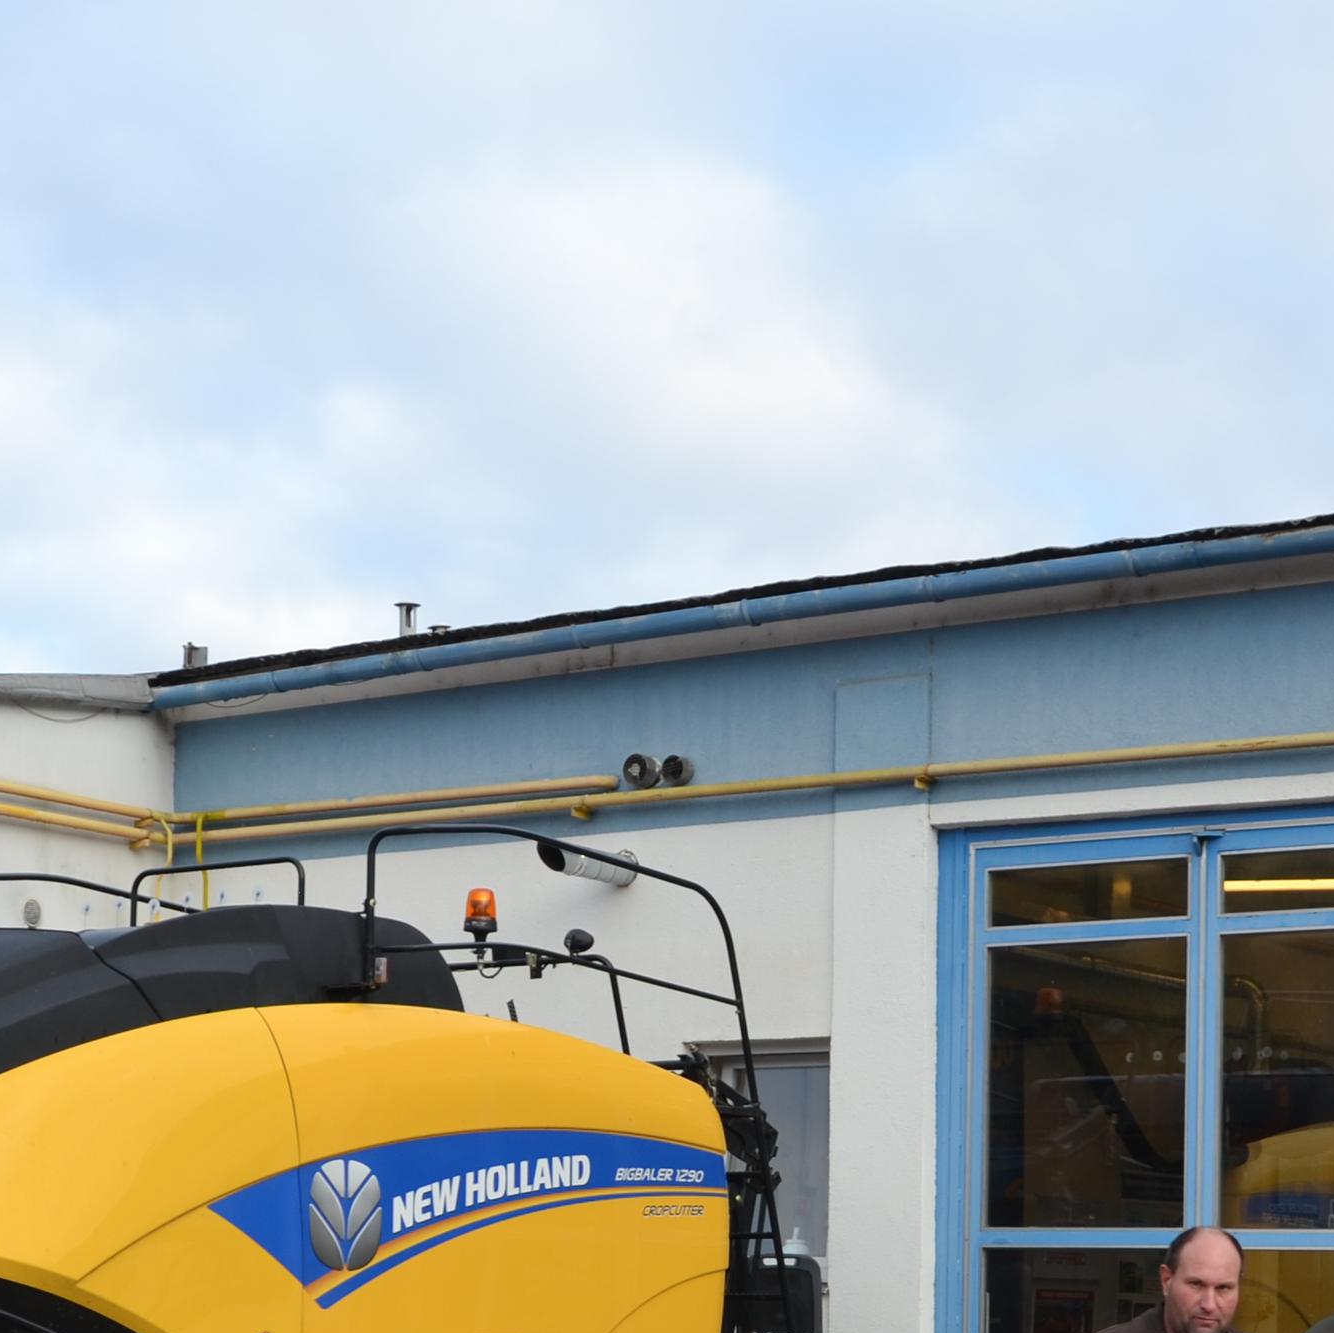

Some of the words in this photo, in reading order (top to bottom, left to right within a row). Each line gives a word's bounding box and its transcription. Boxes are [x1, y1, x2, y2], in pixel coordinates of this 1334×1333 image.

[391, 1176, 461, 1235] NEW
[464, 1153, 592, 1208] HOLLAND
[614, 1167, 673, 1182] BIGBALER
[674, 1169, 705, 1184] 1290
[642, 1205, 705, 1217] CROPCUTTER
